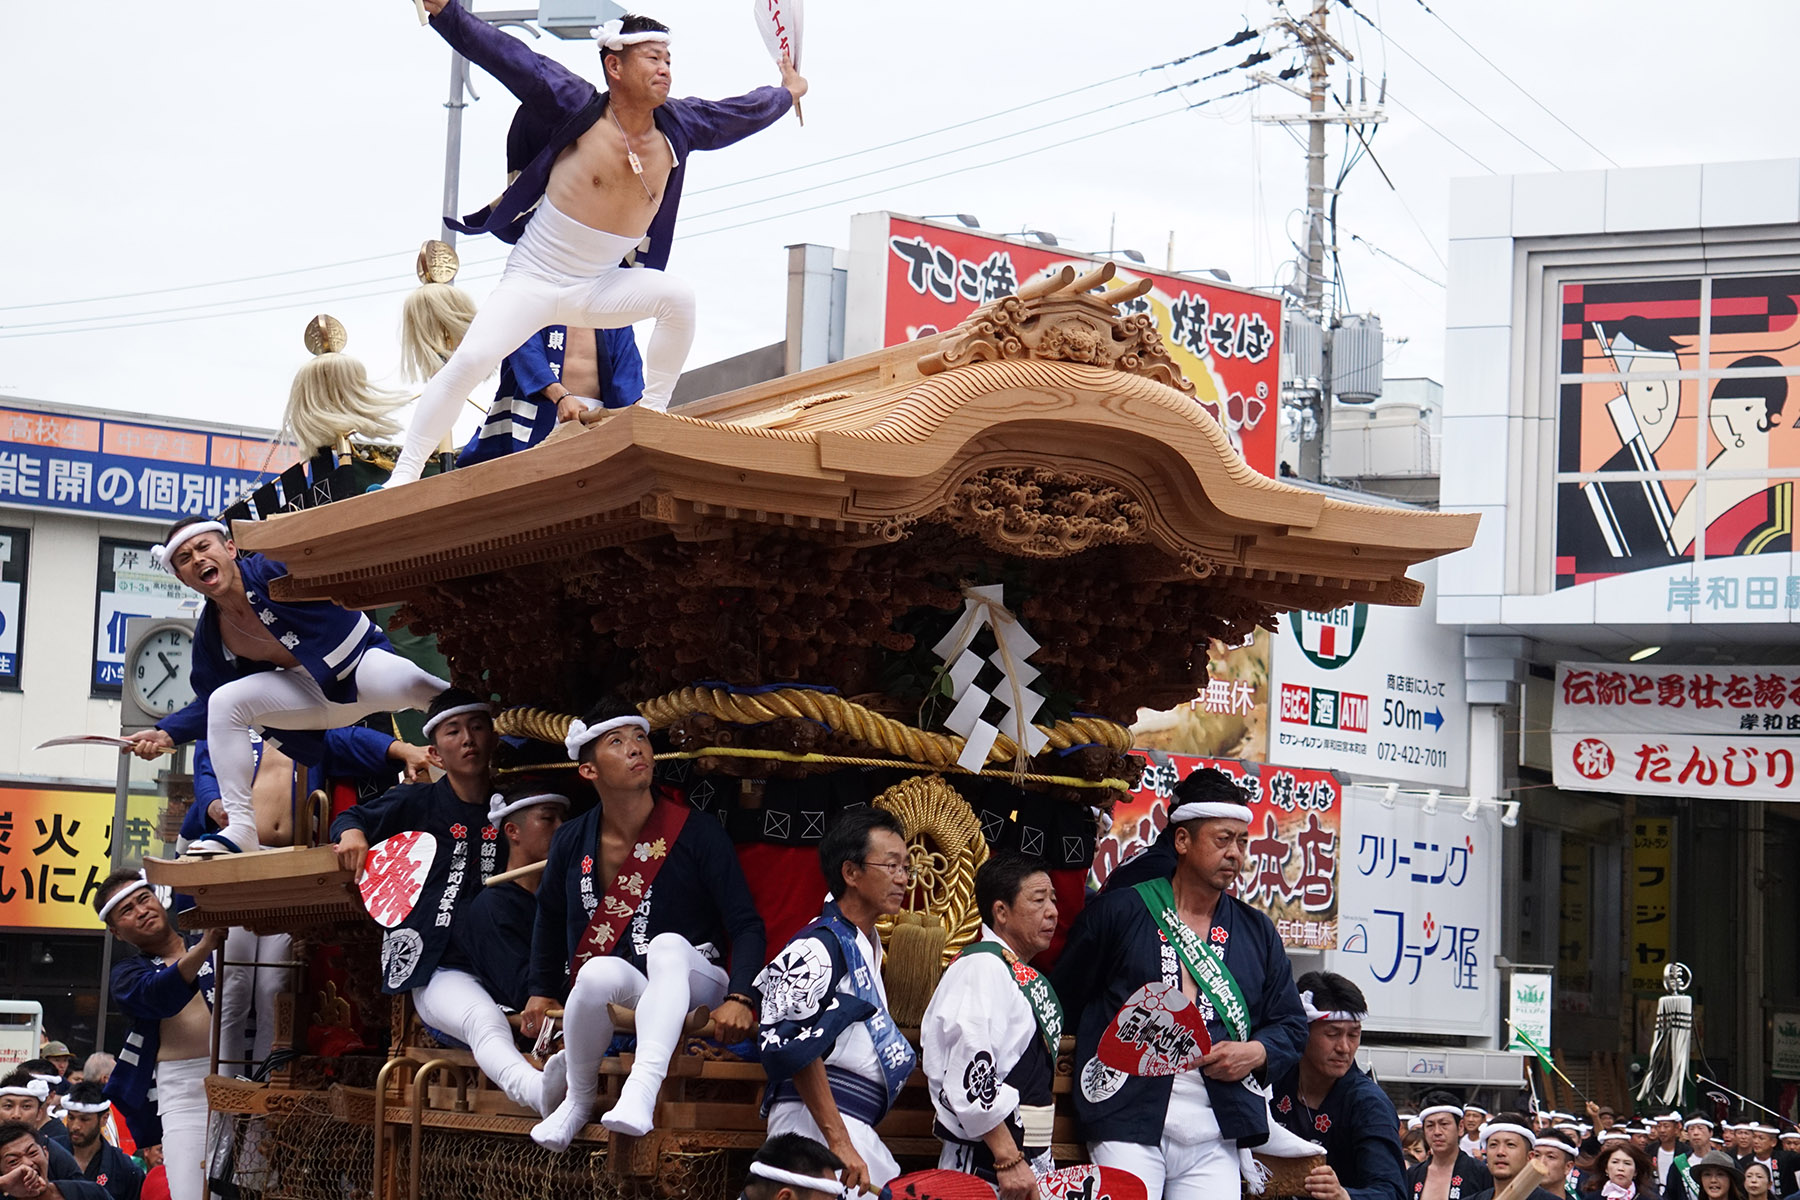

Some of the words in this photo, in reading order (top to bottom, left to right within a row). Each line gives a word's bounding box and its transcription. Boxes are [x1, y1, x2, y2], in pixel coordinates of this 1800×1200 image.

[1171, 290, 1275, 364] 焼そば
[8, 415, 87, 447] 高校生
[0, 450, 287, 520] 能開の個別指
[170, 632, 181, 646] 12
[138, 665, 145, 679] 9
[1386, 674, 1445, 697] 商店街に入って
[1281, 687, 1309, 721] たばこ
[1314, 693, 1335, 725] 酒
[1341, 697, 1368, 729] ATM
[1383, 698, 1422, 730] 50m
[1377, 742, 1447, 769] 072-422-7011
[1576, 742, 1611, 777] 祝
[1634, 744, 1795, 789] だんじり
[1270, 771, 1334, 812] 焼そば
[1357, 834, 1474, 887] クリーニング
[1634, 838, 1669, 849] レストラン
[1277, 918, 1331, 946] 年中無休
[1636, 866, 1666, 965] フジヤ
[1369, 908, 1479, 990] フランス屋
[1116, 1006, 1197, 1067] 副責任者
